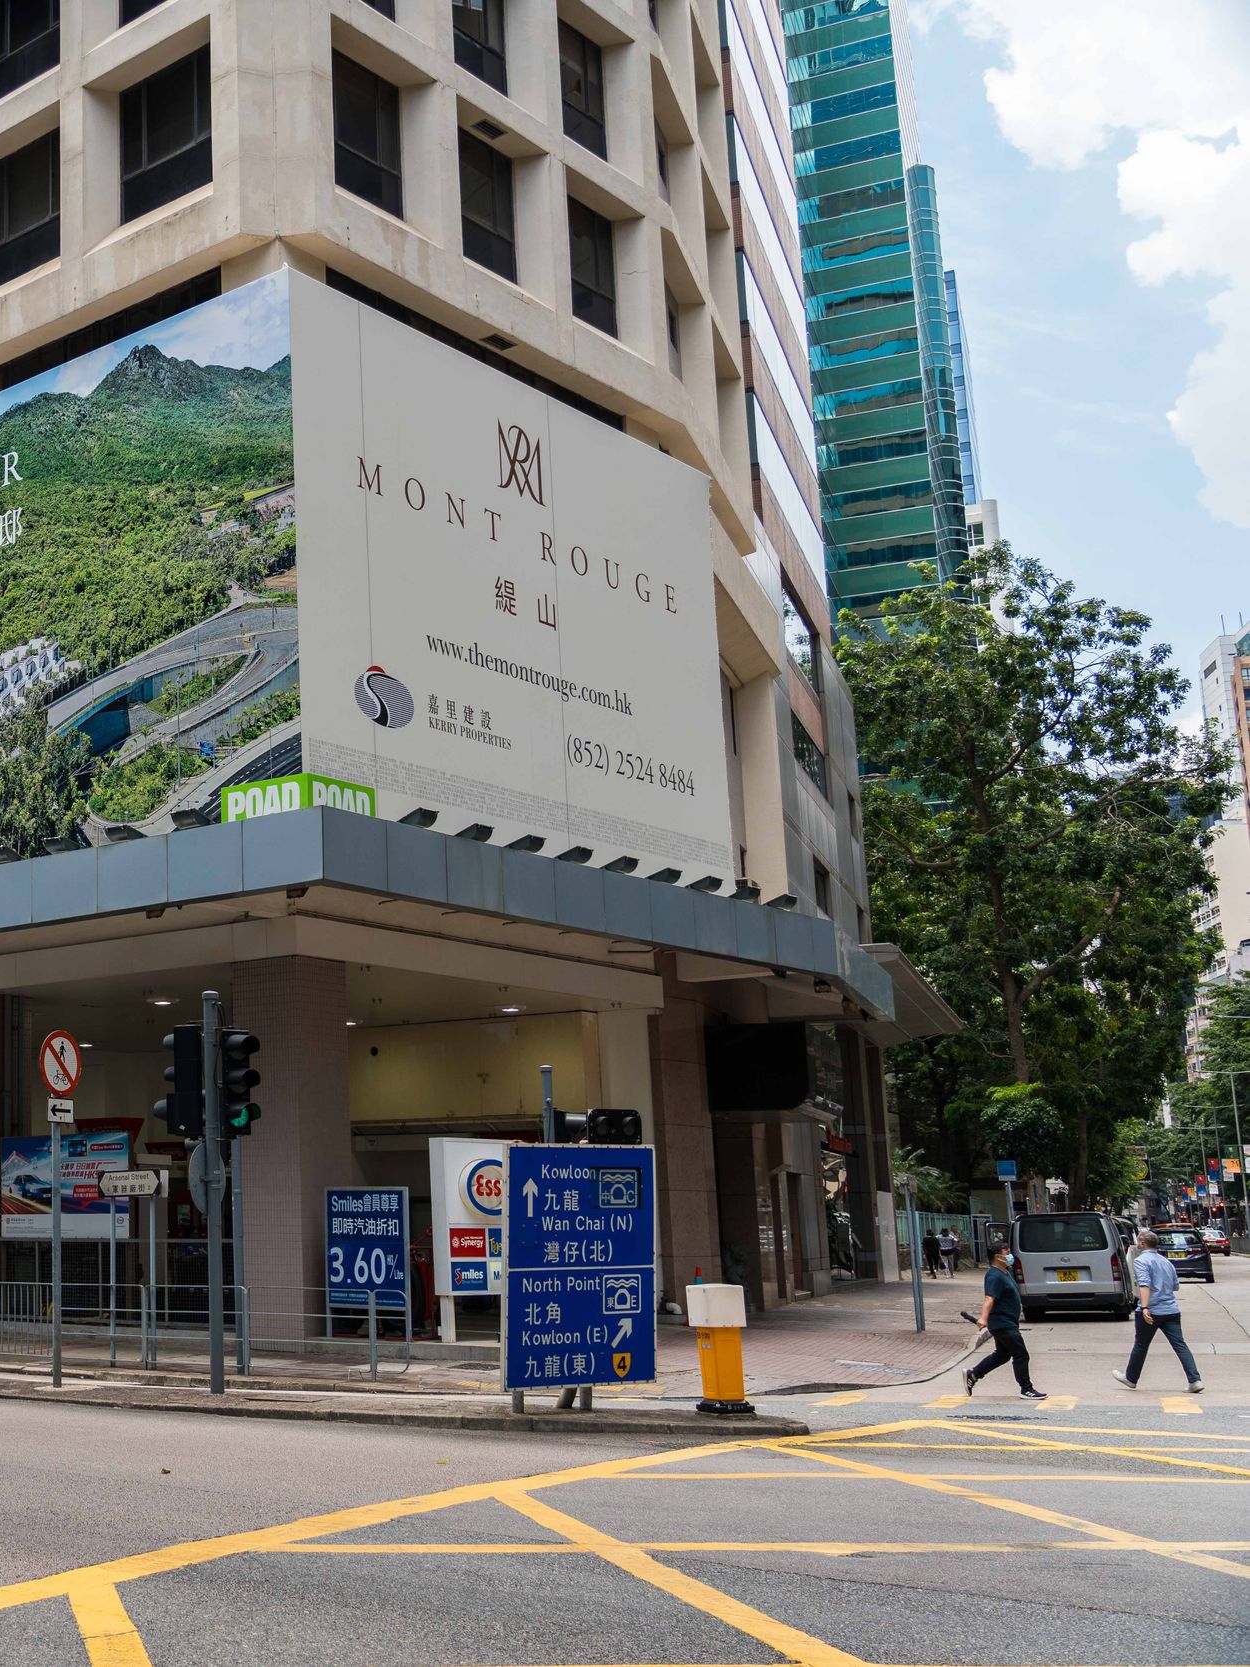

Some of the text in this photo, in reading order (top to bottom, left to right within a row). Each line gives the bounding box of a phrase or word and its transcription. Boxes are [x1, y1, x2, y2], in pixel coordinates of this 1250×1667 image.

[356, 456, 678, 614] MONT ROUGE
[495, 575, 558, 631] 緹山
[426, 633, 633, 716] www.themontrouge.com.hk
[428, 693, 492, 731] 嘉里建設
[429, 716, 512, 751] KERRY PROPERTIES
[566, 732, 695, 797] (852) 2524 8484
[227, 781, 301, 823] POAD
[108, 1172, 150, 1182] Arsenal Street
[541, 1164, 596, 1179] Kowloon
[475, 1174, 502, 1198] Ess
[601, 1190, 610, 1204] 中
[626, 1190, 635, 1203] C
[544, 1189, 580, 1211] 九龍
[332, 1217, 400, 1236] 即時汽油折扣
[541, 1213, 633, 1232] Wan Chai (N)
[460, 1237, 484, 1249] Synergy
[543, 1239, 613, 1263] 灣仔(北)
[330, 1246, 387, 1285] 3.60
[455, 1267, 484, 1285] Smiles
[522, 1276, 601, 1293] North Point
[606, 1297, 615, 1308] 東
[630, 1295, 637, 1307] E
[524, 1301, 561, 1325] 北角
[522, 1324, 608, 1346] Kowloon (E)
[524, 1351, 596, 1379] 九龍(東)
[616, 1356, 627, 1371] 4
